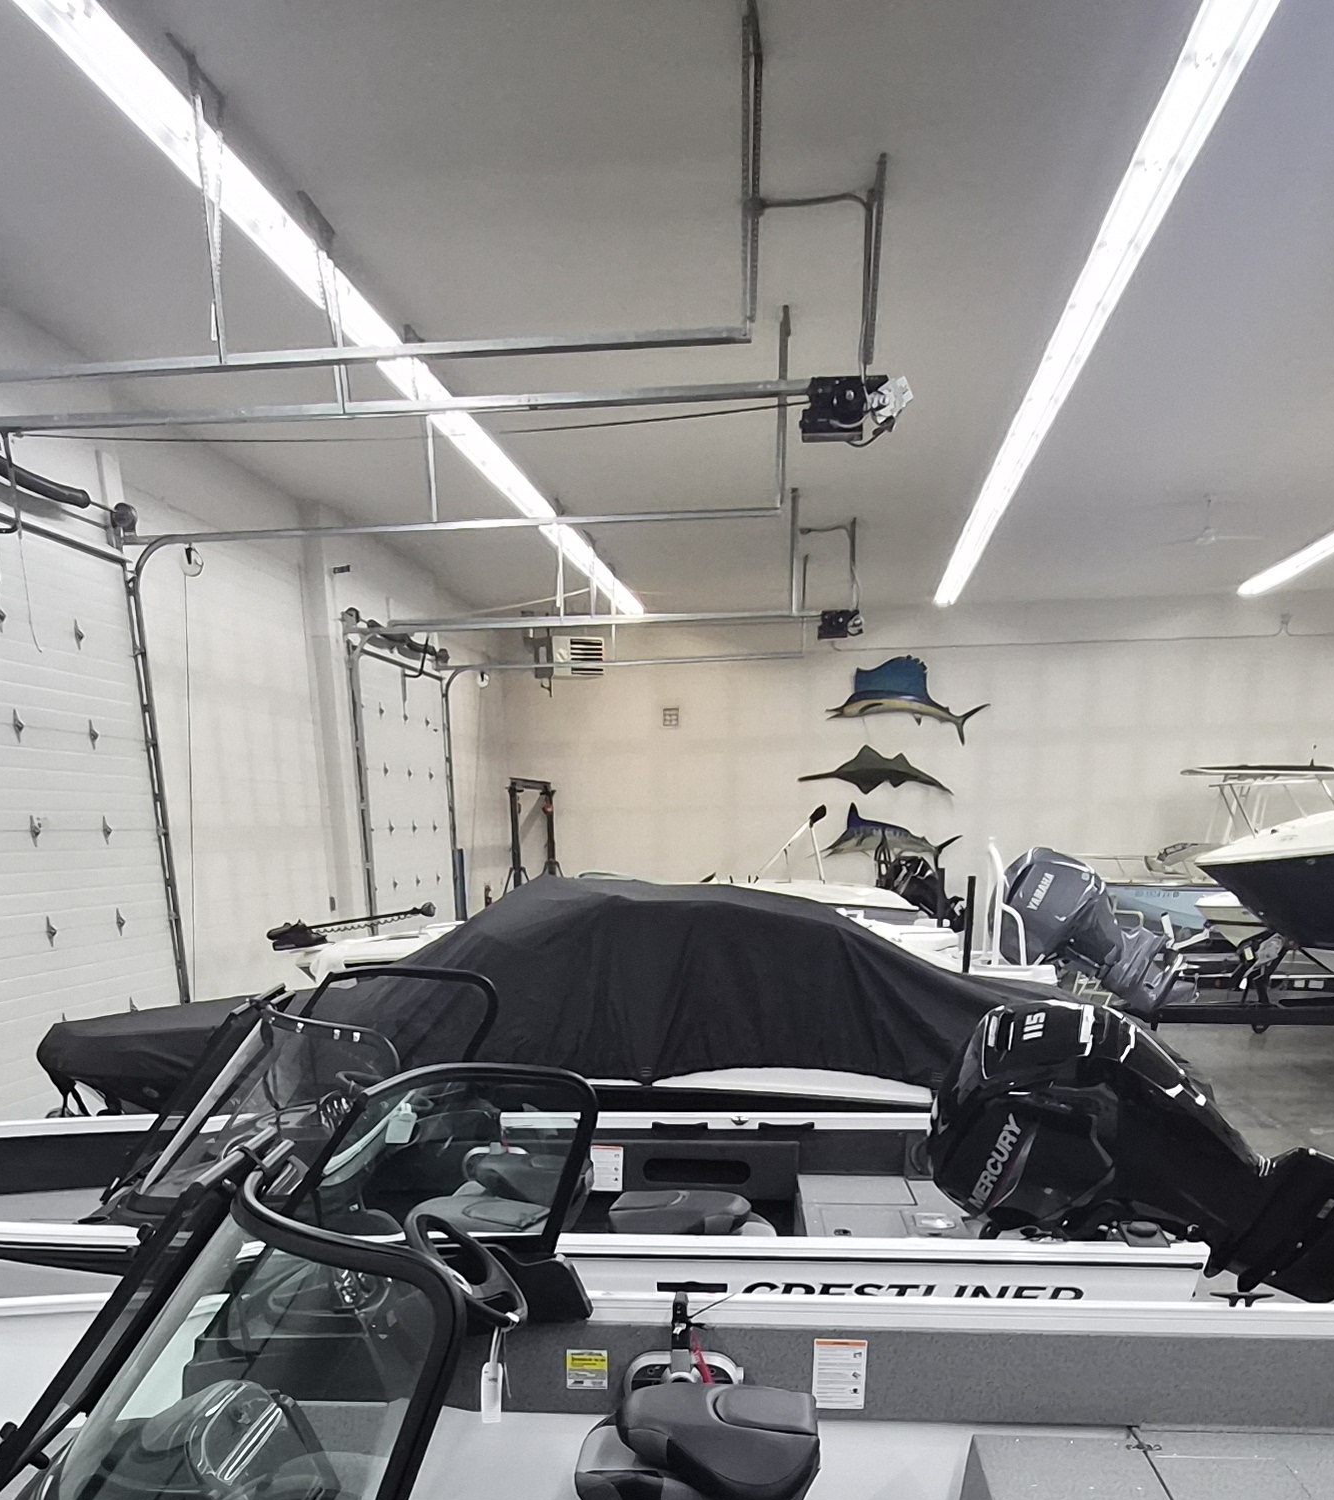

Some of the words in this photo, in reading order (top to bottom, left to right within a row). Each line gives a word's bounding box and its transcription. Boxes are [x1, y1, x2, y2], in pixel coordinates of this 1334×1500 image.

[1026, 872, 1055, 911] YAMAHA
[1021, 1011, 1046, 1041] 115
[968, 1112, 1022, 1209] MERCURY
